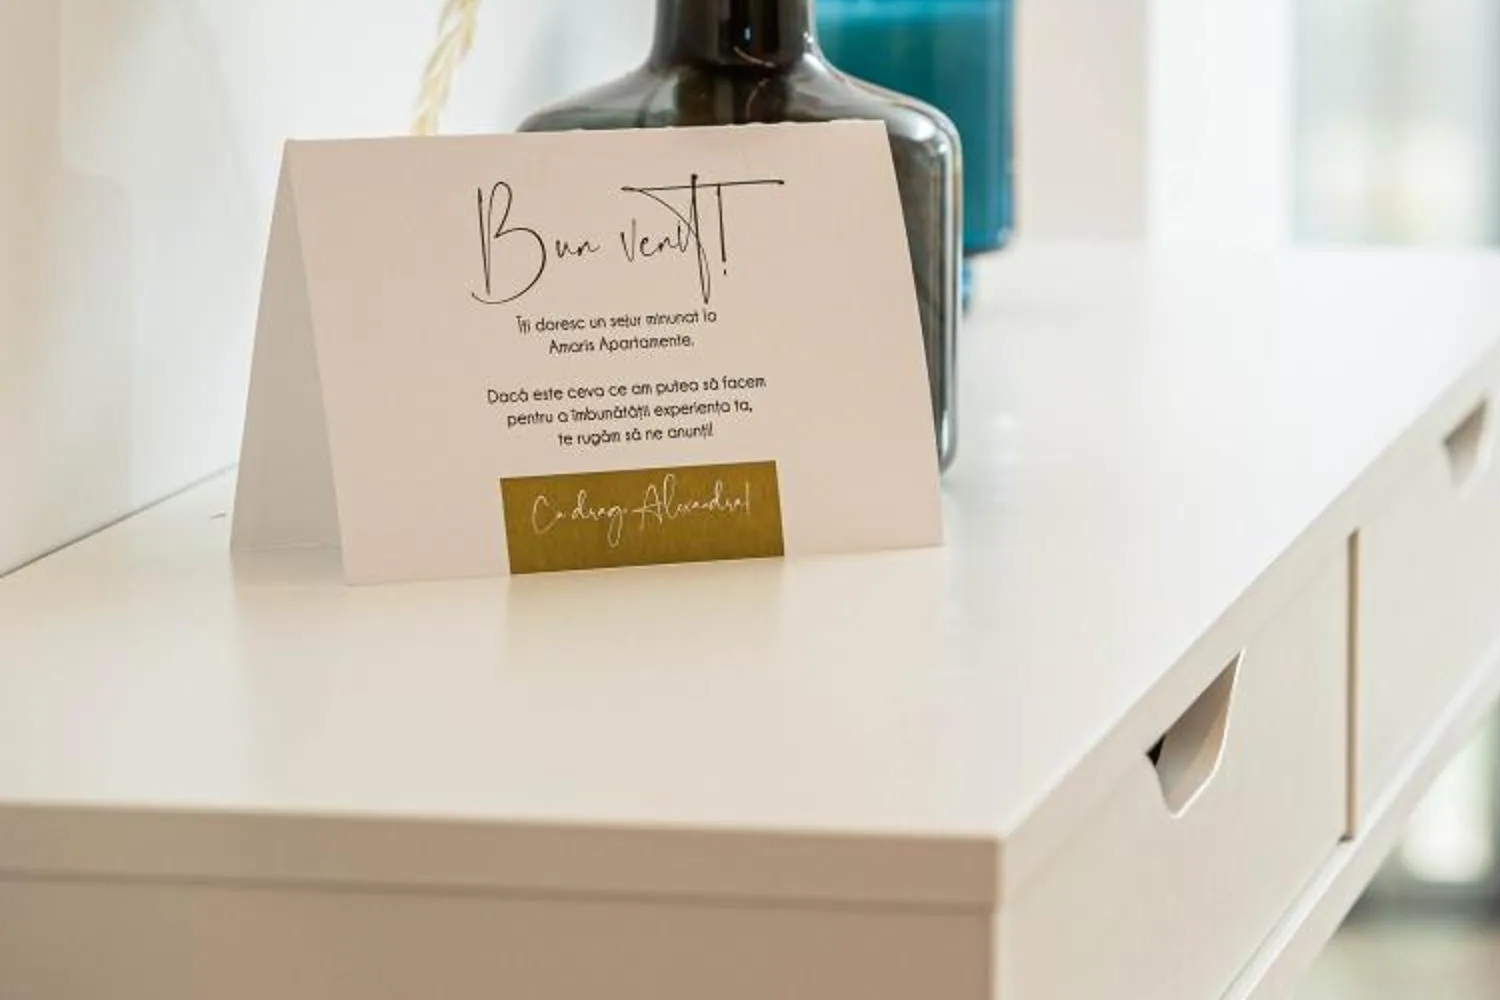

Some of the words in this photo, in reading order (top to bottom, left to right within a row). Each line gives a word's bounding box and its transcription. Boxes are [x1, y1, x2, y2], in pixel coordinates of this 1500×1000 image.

[471, 180, 602, 306] Bun
[535, 317, 585, 332] doresc
[589, 318, 606, 329] un
[610, 314, 641, 328] sejur
[646, 311, 699, 325] minunat
[703, 309, 717, 323] la
[549, 339, 595, 354] Amaris
[599, 334, 694, 353] Apartamente.
[487, 388, 528, 405] Dacă
[533, 388, 563, 401] este
[567, 387, 605, 399] ceva
[608, 385, 627, 397] ce
[631, 384, 652, 395] am
[656, 380, 699, 396] putea
[703, 377, 719, 391] să
[722, 376, 766, 390] facem
[507, 411, 553, 428] pentru
[557, 412, 569, 423] a
[734, 400, 752, 413] ta,
[558, 433, 573, 446] te
[577, 429, 621, 447] rugăm
[625, 428, 642, 441] să
[645, 429, 663, 440] ne
